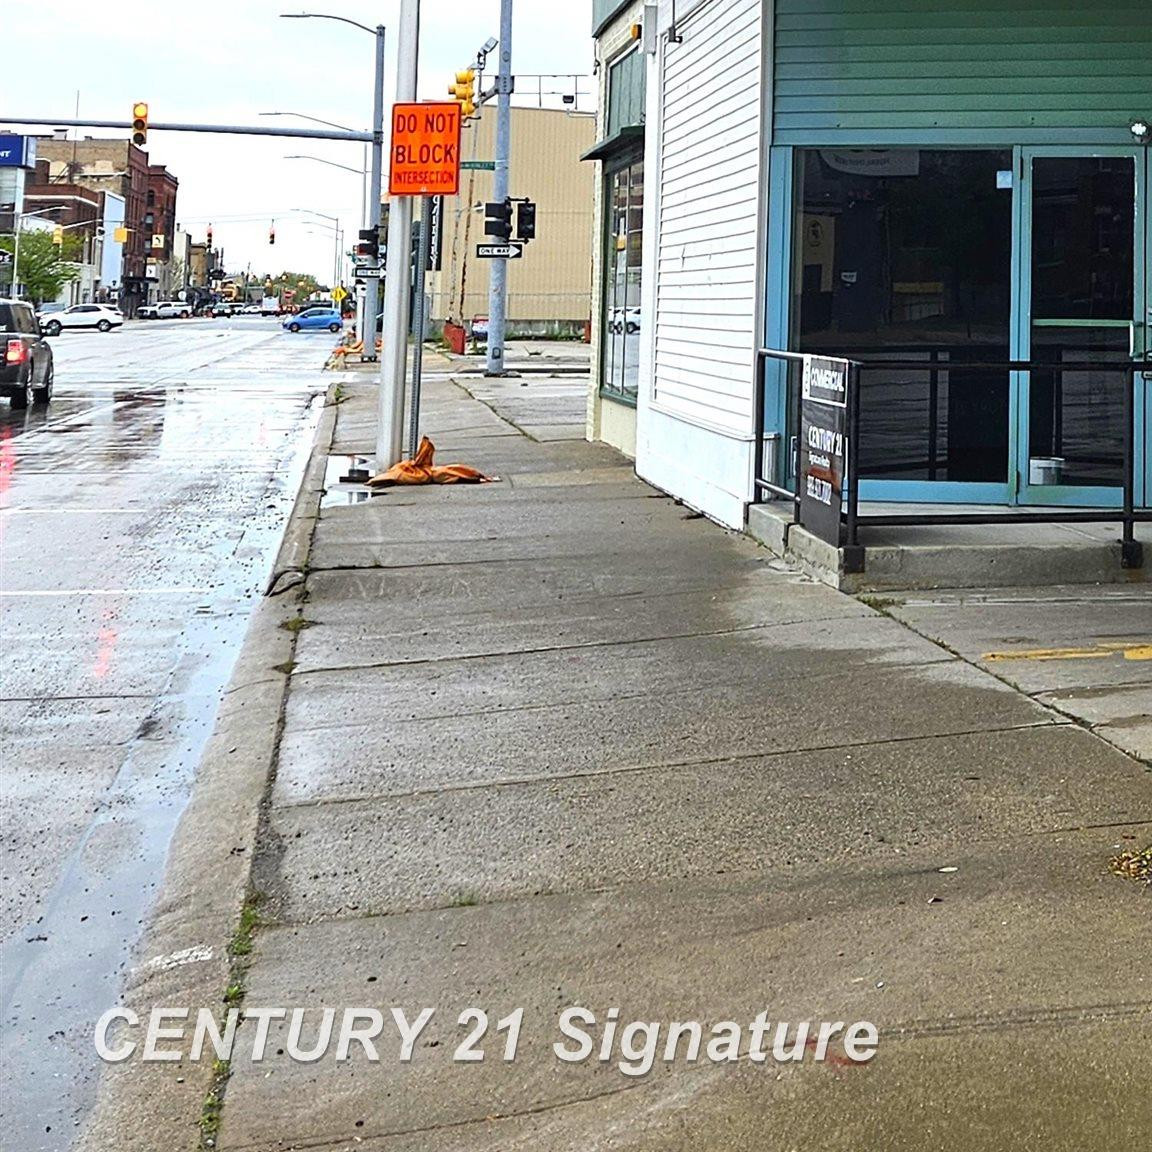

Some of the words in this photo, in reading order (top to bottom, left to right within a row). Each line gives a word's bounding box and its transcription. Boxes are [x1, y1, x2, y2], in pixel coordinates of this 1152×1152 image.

[396, 113, 417, 133] DO
[424, 113, 456, 133] NOT
[395, 144, 455, 164] BLOCK
[395, 171, 454, 184] INTERSECTION
[808, 425, 835, 453] CENTURY
[835, 433, 842, 456] 21
